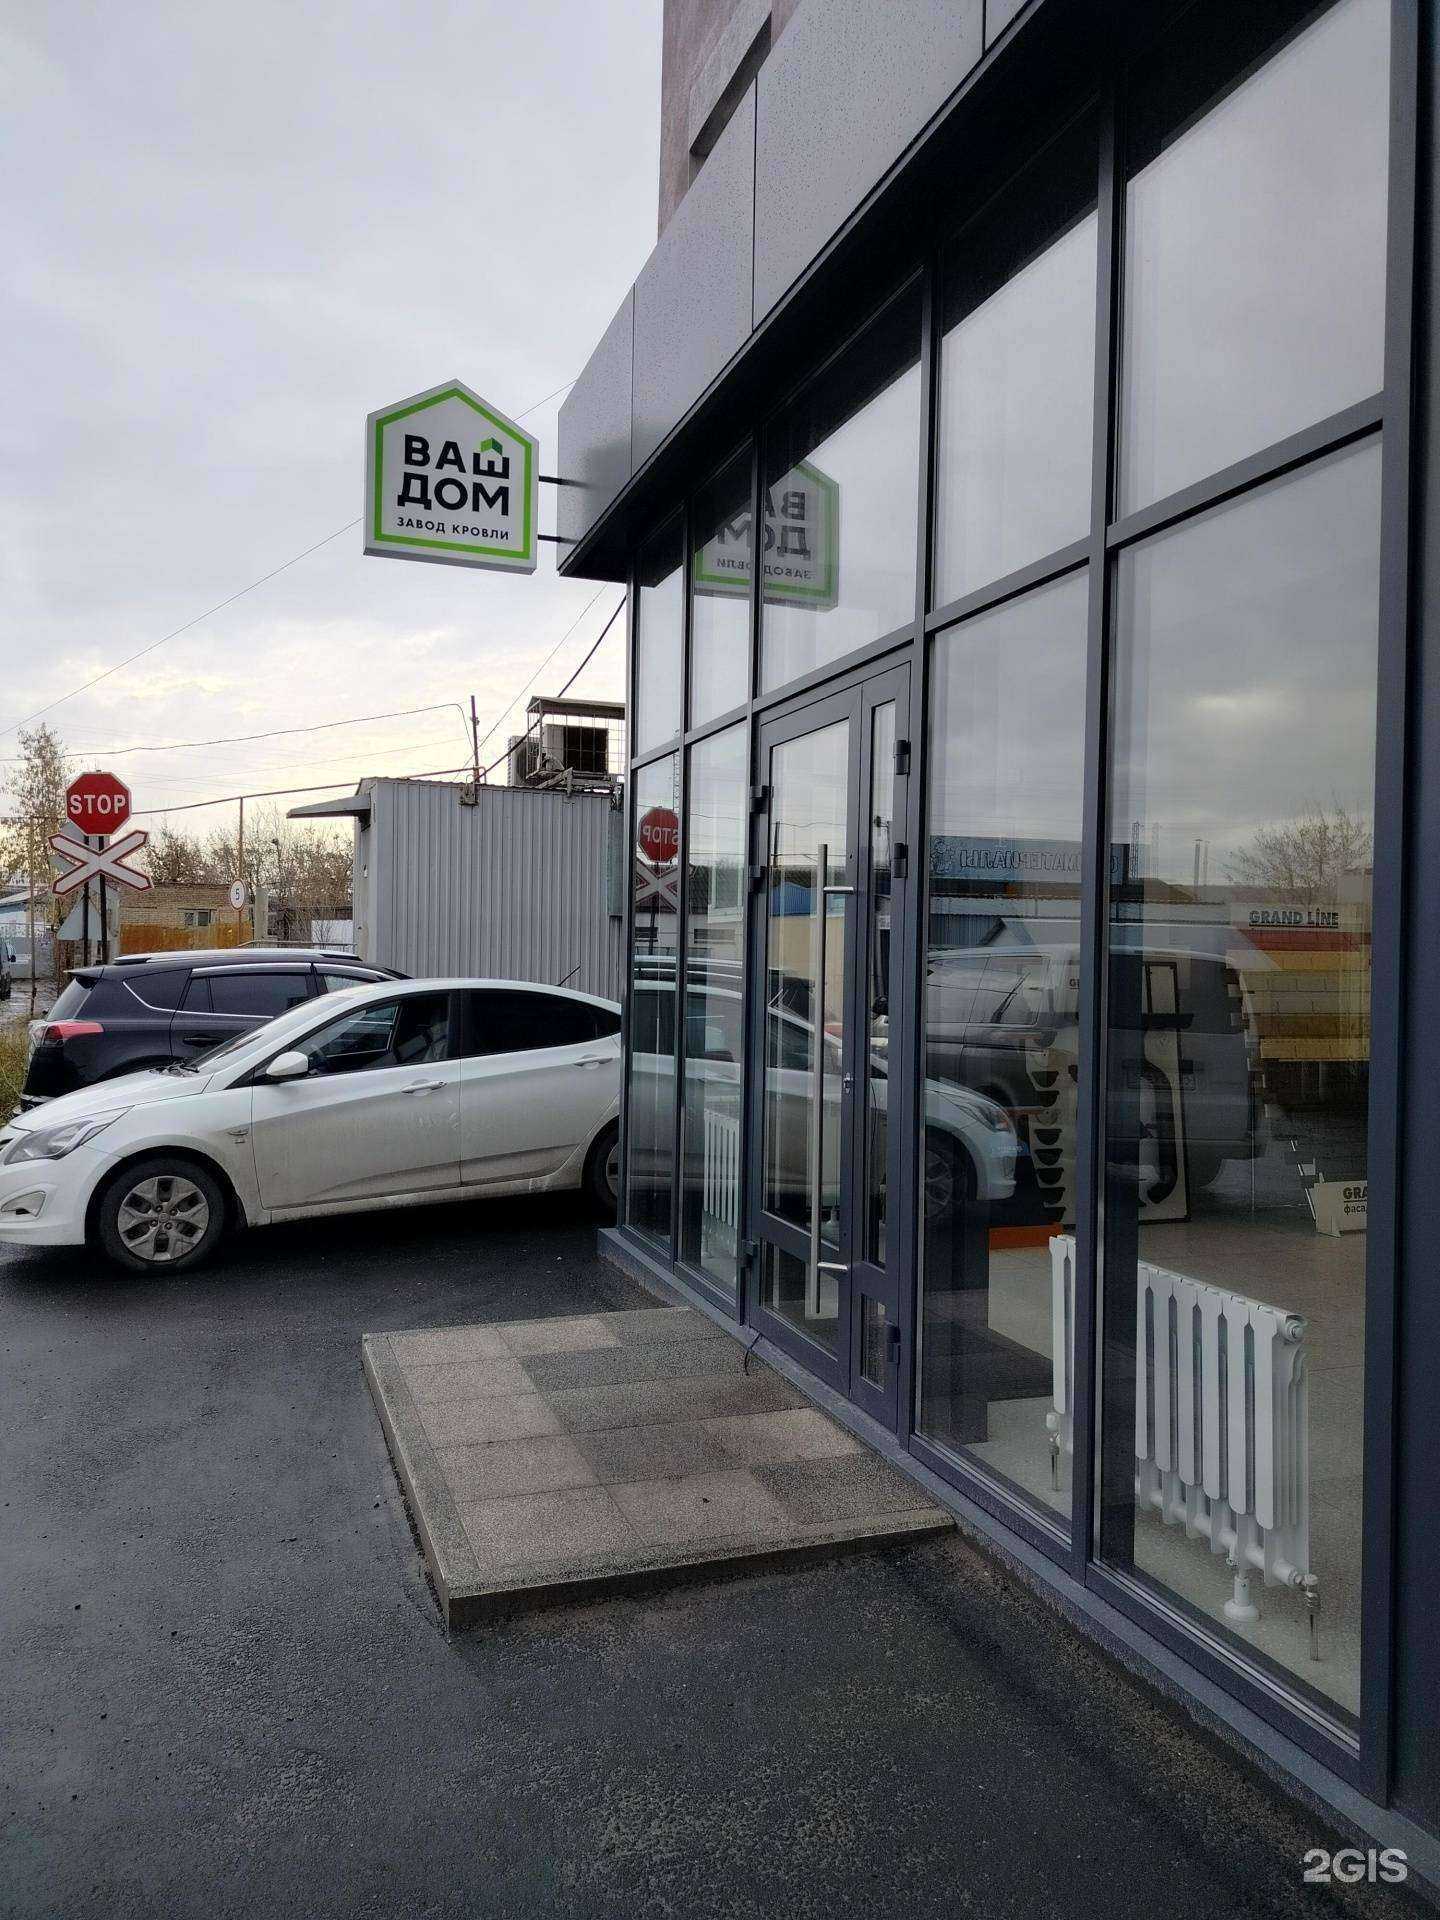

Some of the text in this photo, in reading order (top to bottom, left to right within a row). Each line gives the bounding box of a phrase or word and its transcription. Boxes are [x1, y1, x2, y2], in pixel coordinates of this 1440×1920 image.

[404, 434, 510, 480] ВАШ
[397, 472, 510, 517] ДОМ
[396, 517, 510, 541] ЗАВОД КРОВЛИ
[70, 794, 126, 815] STOP
[1248, 910, 1303, 925] GRAND
[1343, 1204, 1368, 1216] фаса
